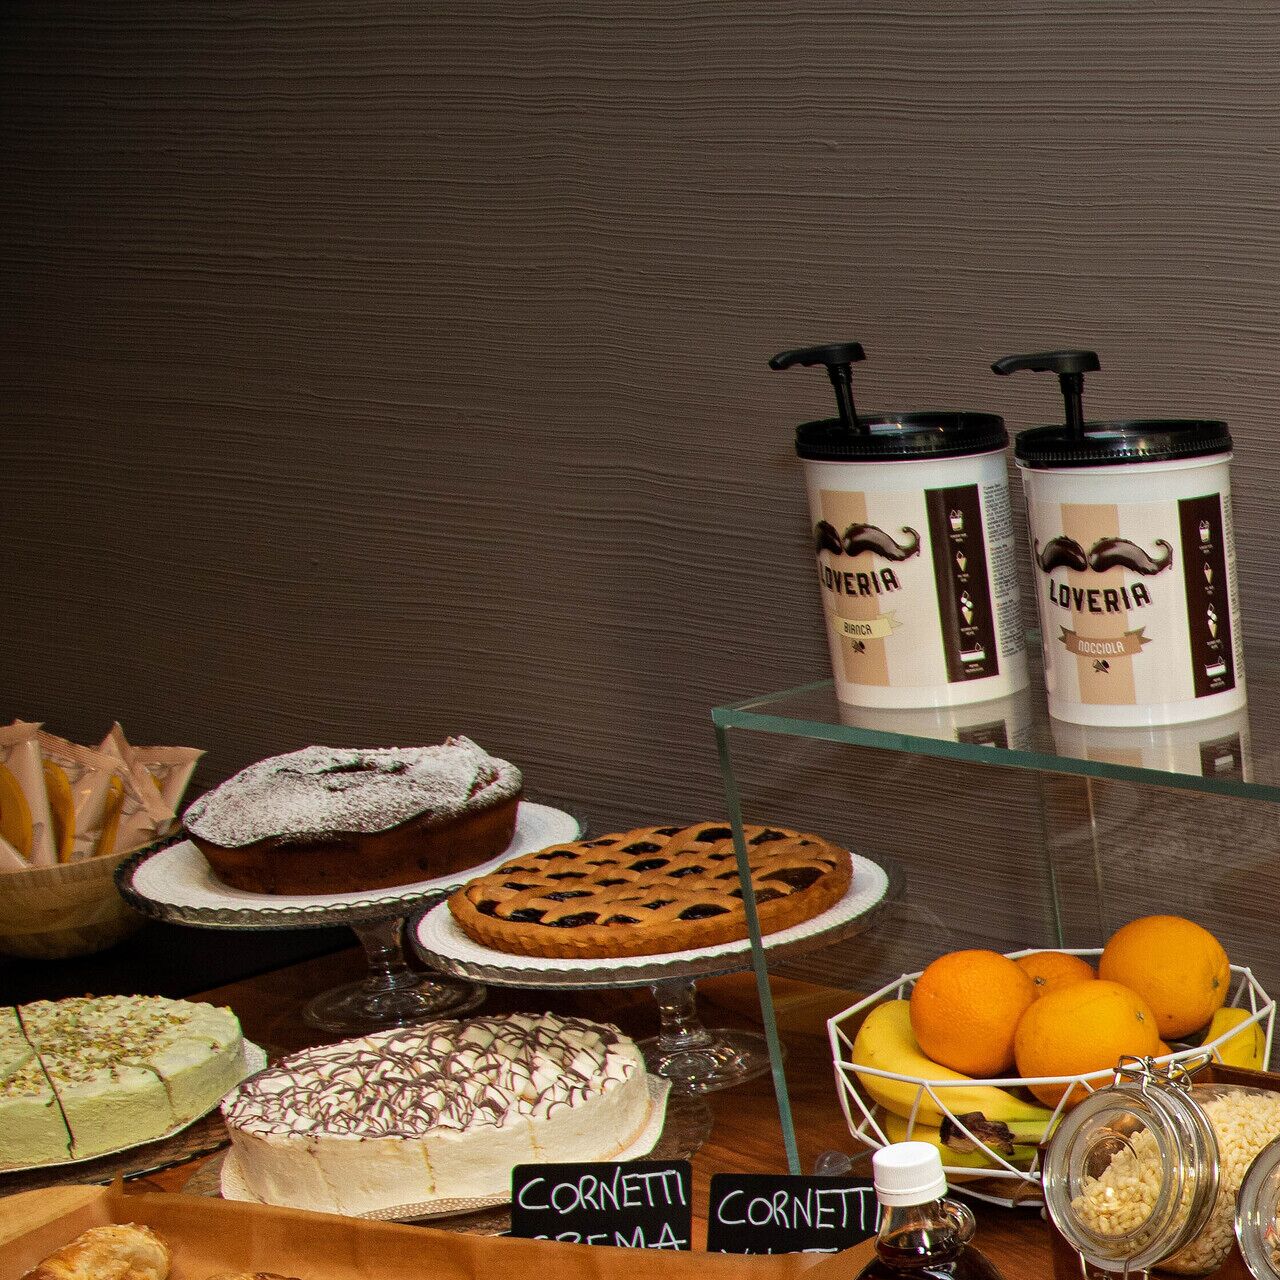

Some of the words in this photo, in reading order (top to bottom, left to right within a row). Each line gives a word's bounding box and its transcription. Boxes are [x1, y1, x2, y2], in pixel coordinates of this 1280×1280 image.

[1050, 579, 1152, 613] LOVERIA
[1078, 640, 1125, 655] NOCCIOLA
[518, 1166, 687, 1214] CORNETTI
[718, 1188, 881, 1232] CORNETTI
